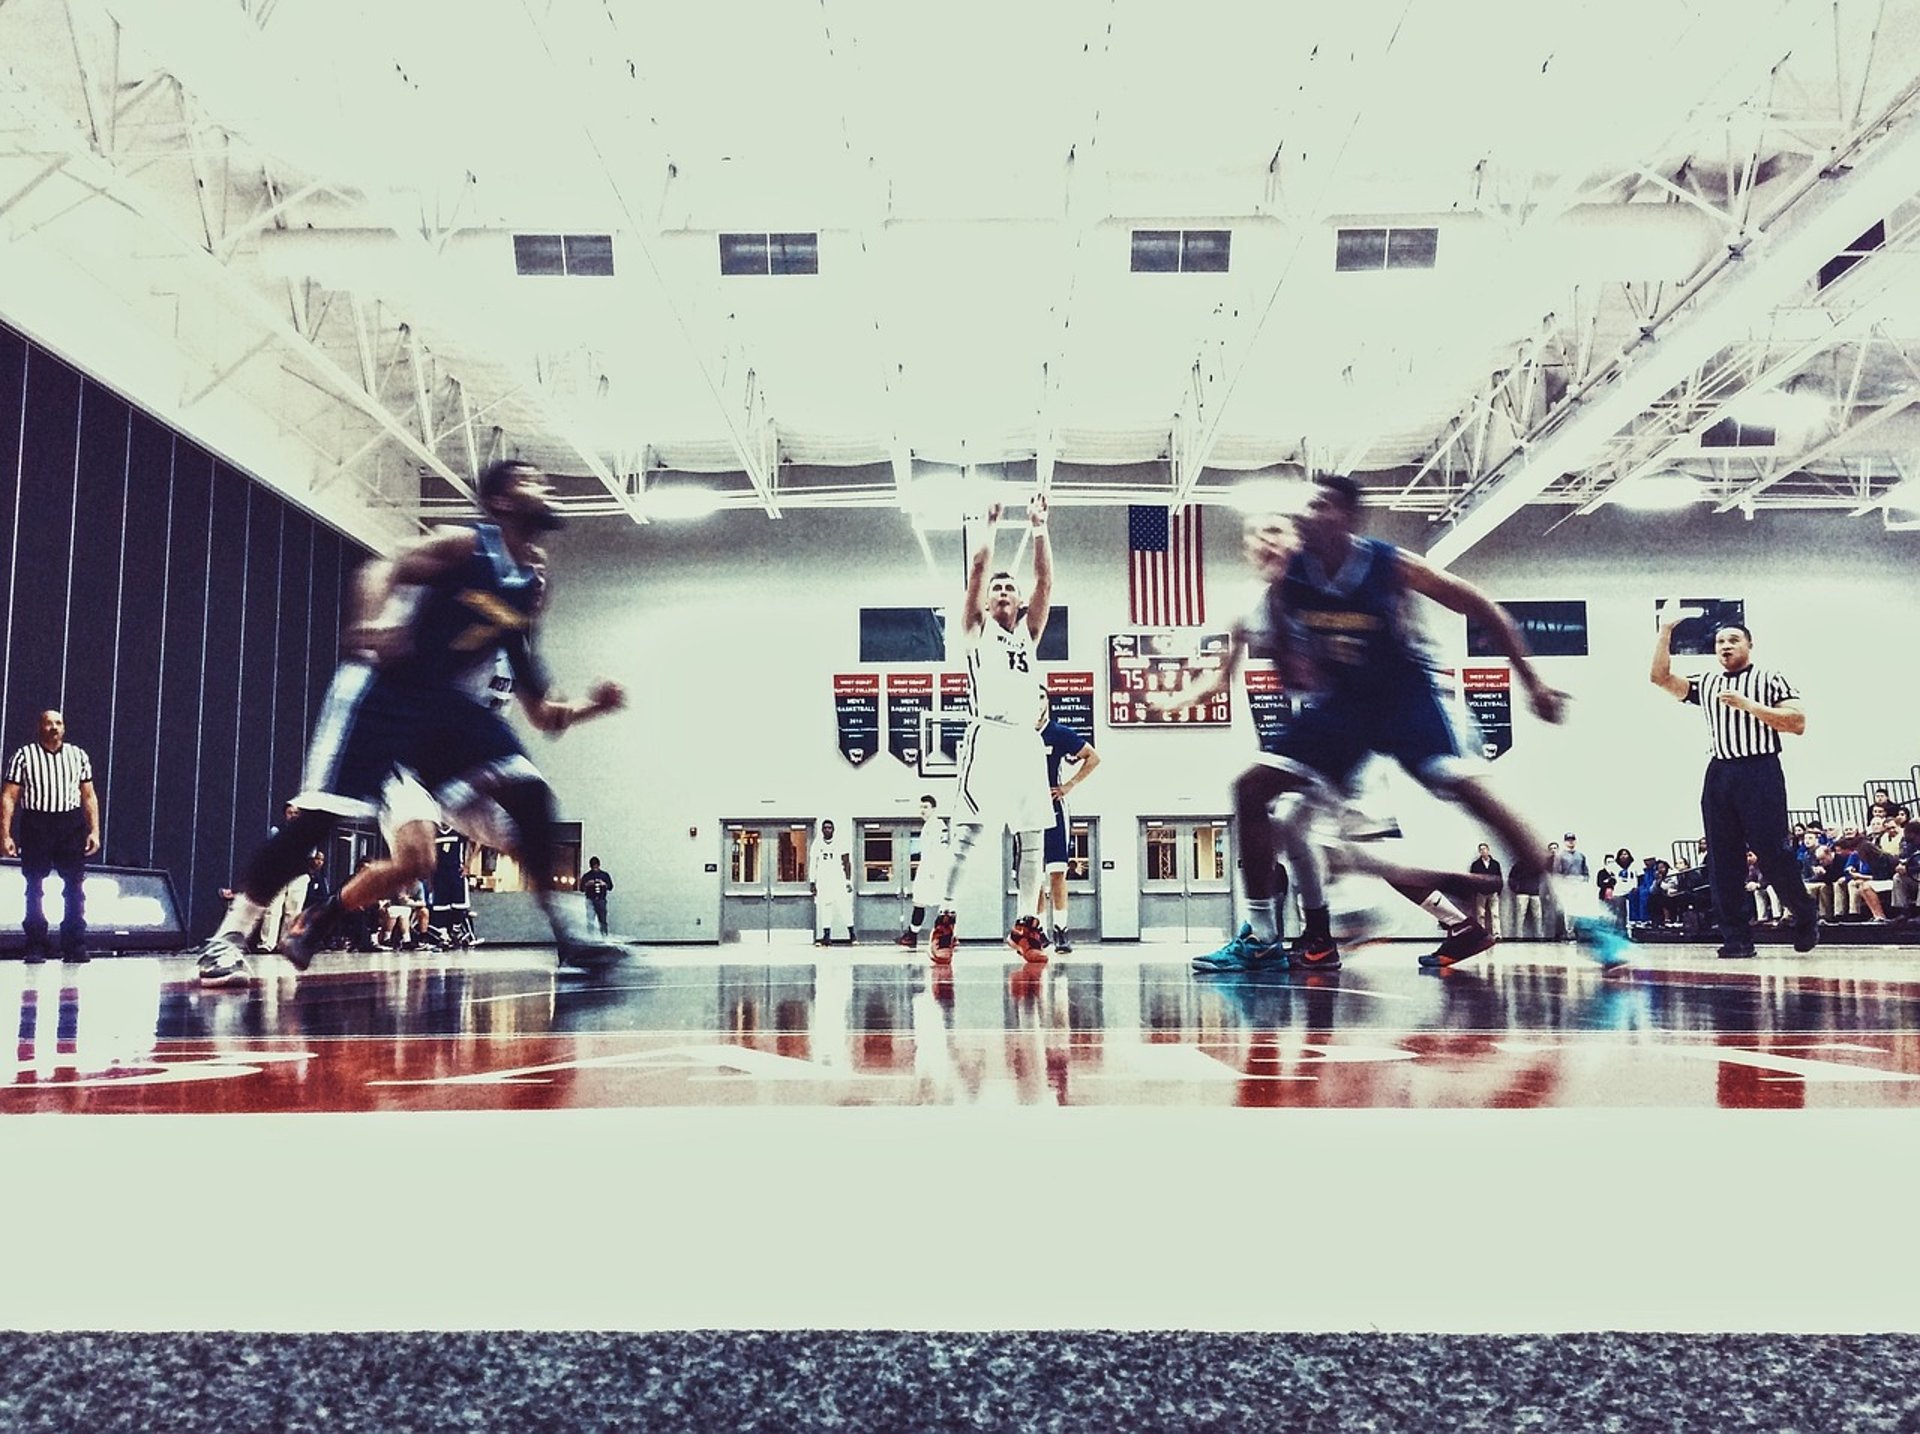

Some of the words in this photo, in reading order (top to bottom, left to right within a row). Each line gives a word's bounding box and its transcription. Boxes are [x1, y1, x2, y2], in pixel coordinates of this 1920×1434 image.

[1006, 650, 1029, 673] 15
[1120, 670, 1145, 690] 75
[1114, 705, 1129, 721] 10
[1212, 704, 1228, 721] 10
[823, 852, 834, 860] 21
